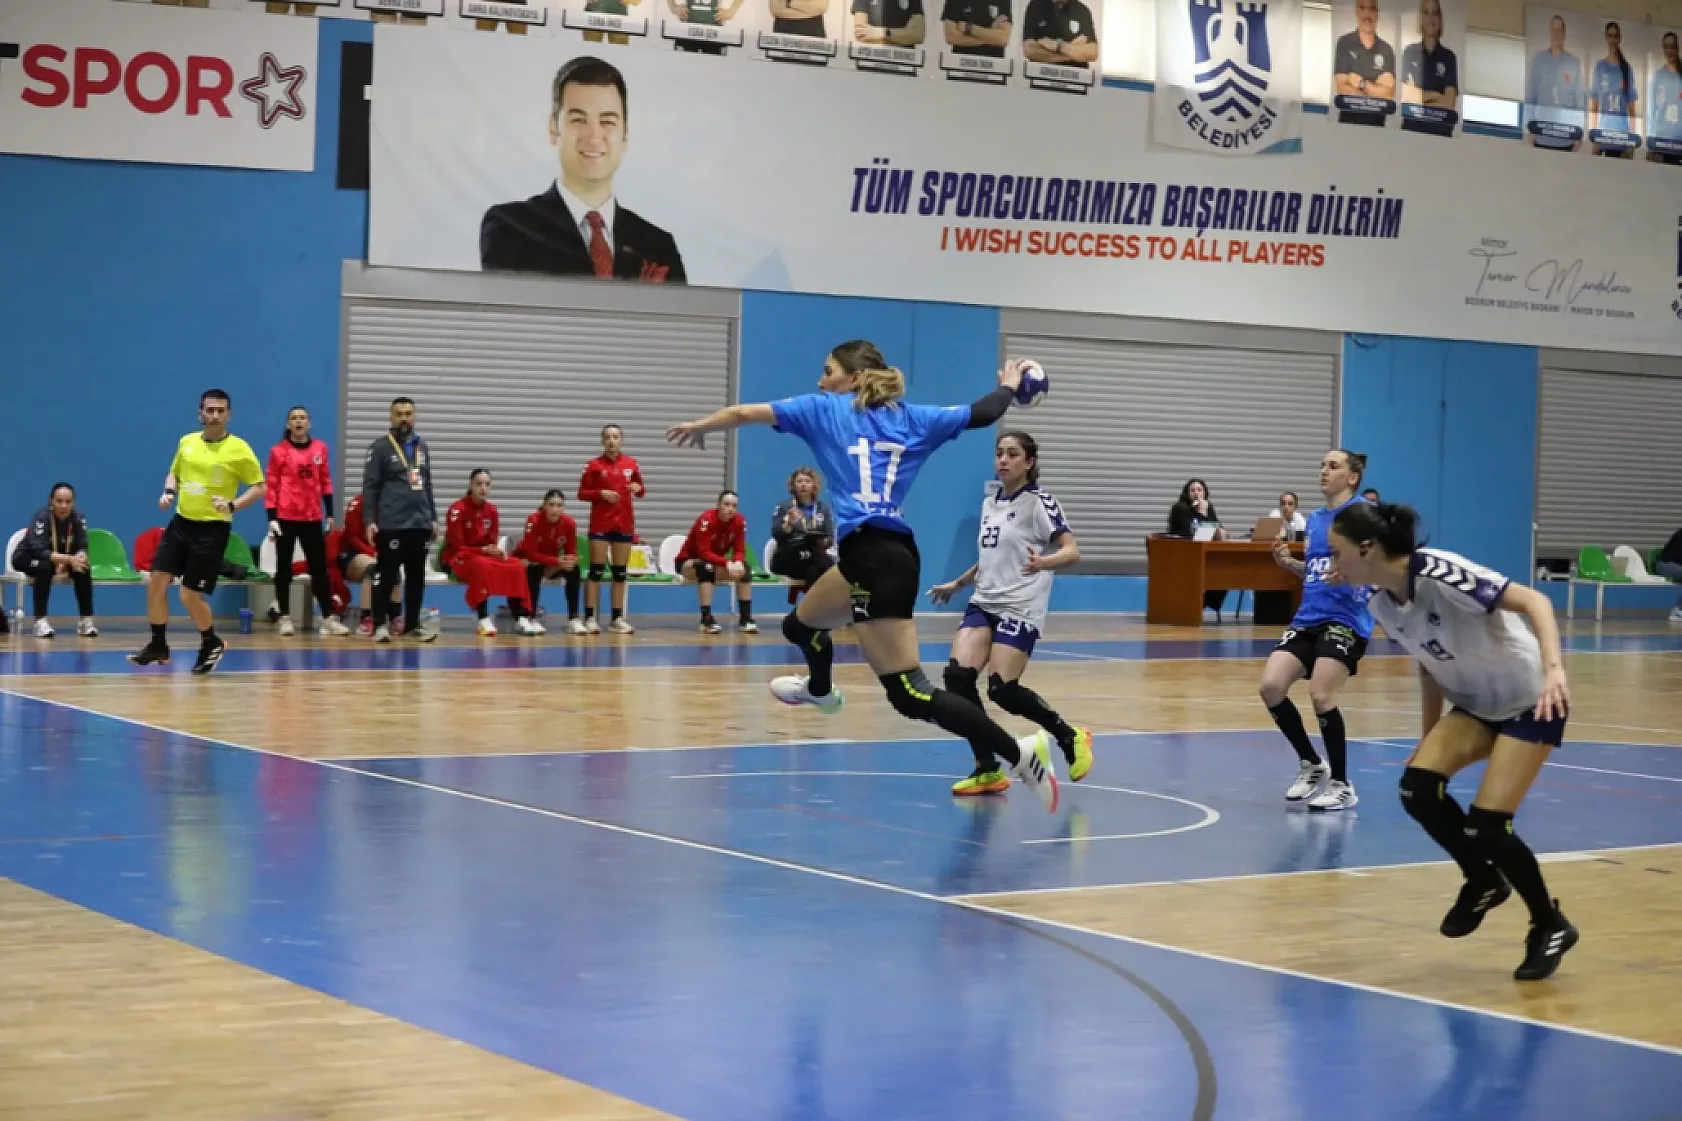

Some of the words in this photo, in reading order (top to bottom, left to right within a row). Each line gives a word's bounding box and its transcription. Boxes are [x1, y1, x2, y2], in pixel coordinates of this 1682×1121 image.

[1178, 99, 1277, 149] BELEDİYESİ
[850, 157, 914, 214] TÜM
[918, 170, 1157, 226] SPORCULARIMIZA
[1161, 184, 1303, 237] BAŞARILAR
[1306, 185, 1404, 239] DİLERİM
[940, 226, 949, 251] I
[954, 226, 1022, 253] WISH
[1027, 230, 1141, 259] SUCCESS
[1146, 236, 1177, 260] TO
[1180, 238, 1222, 262] ALL
[1227, 240, 1325, 267] PLAYERS
[848, 437, 906, 502] 17
[981, 525, 1000, 549] 23
